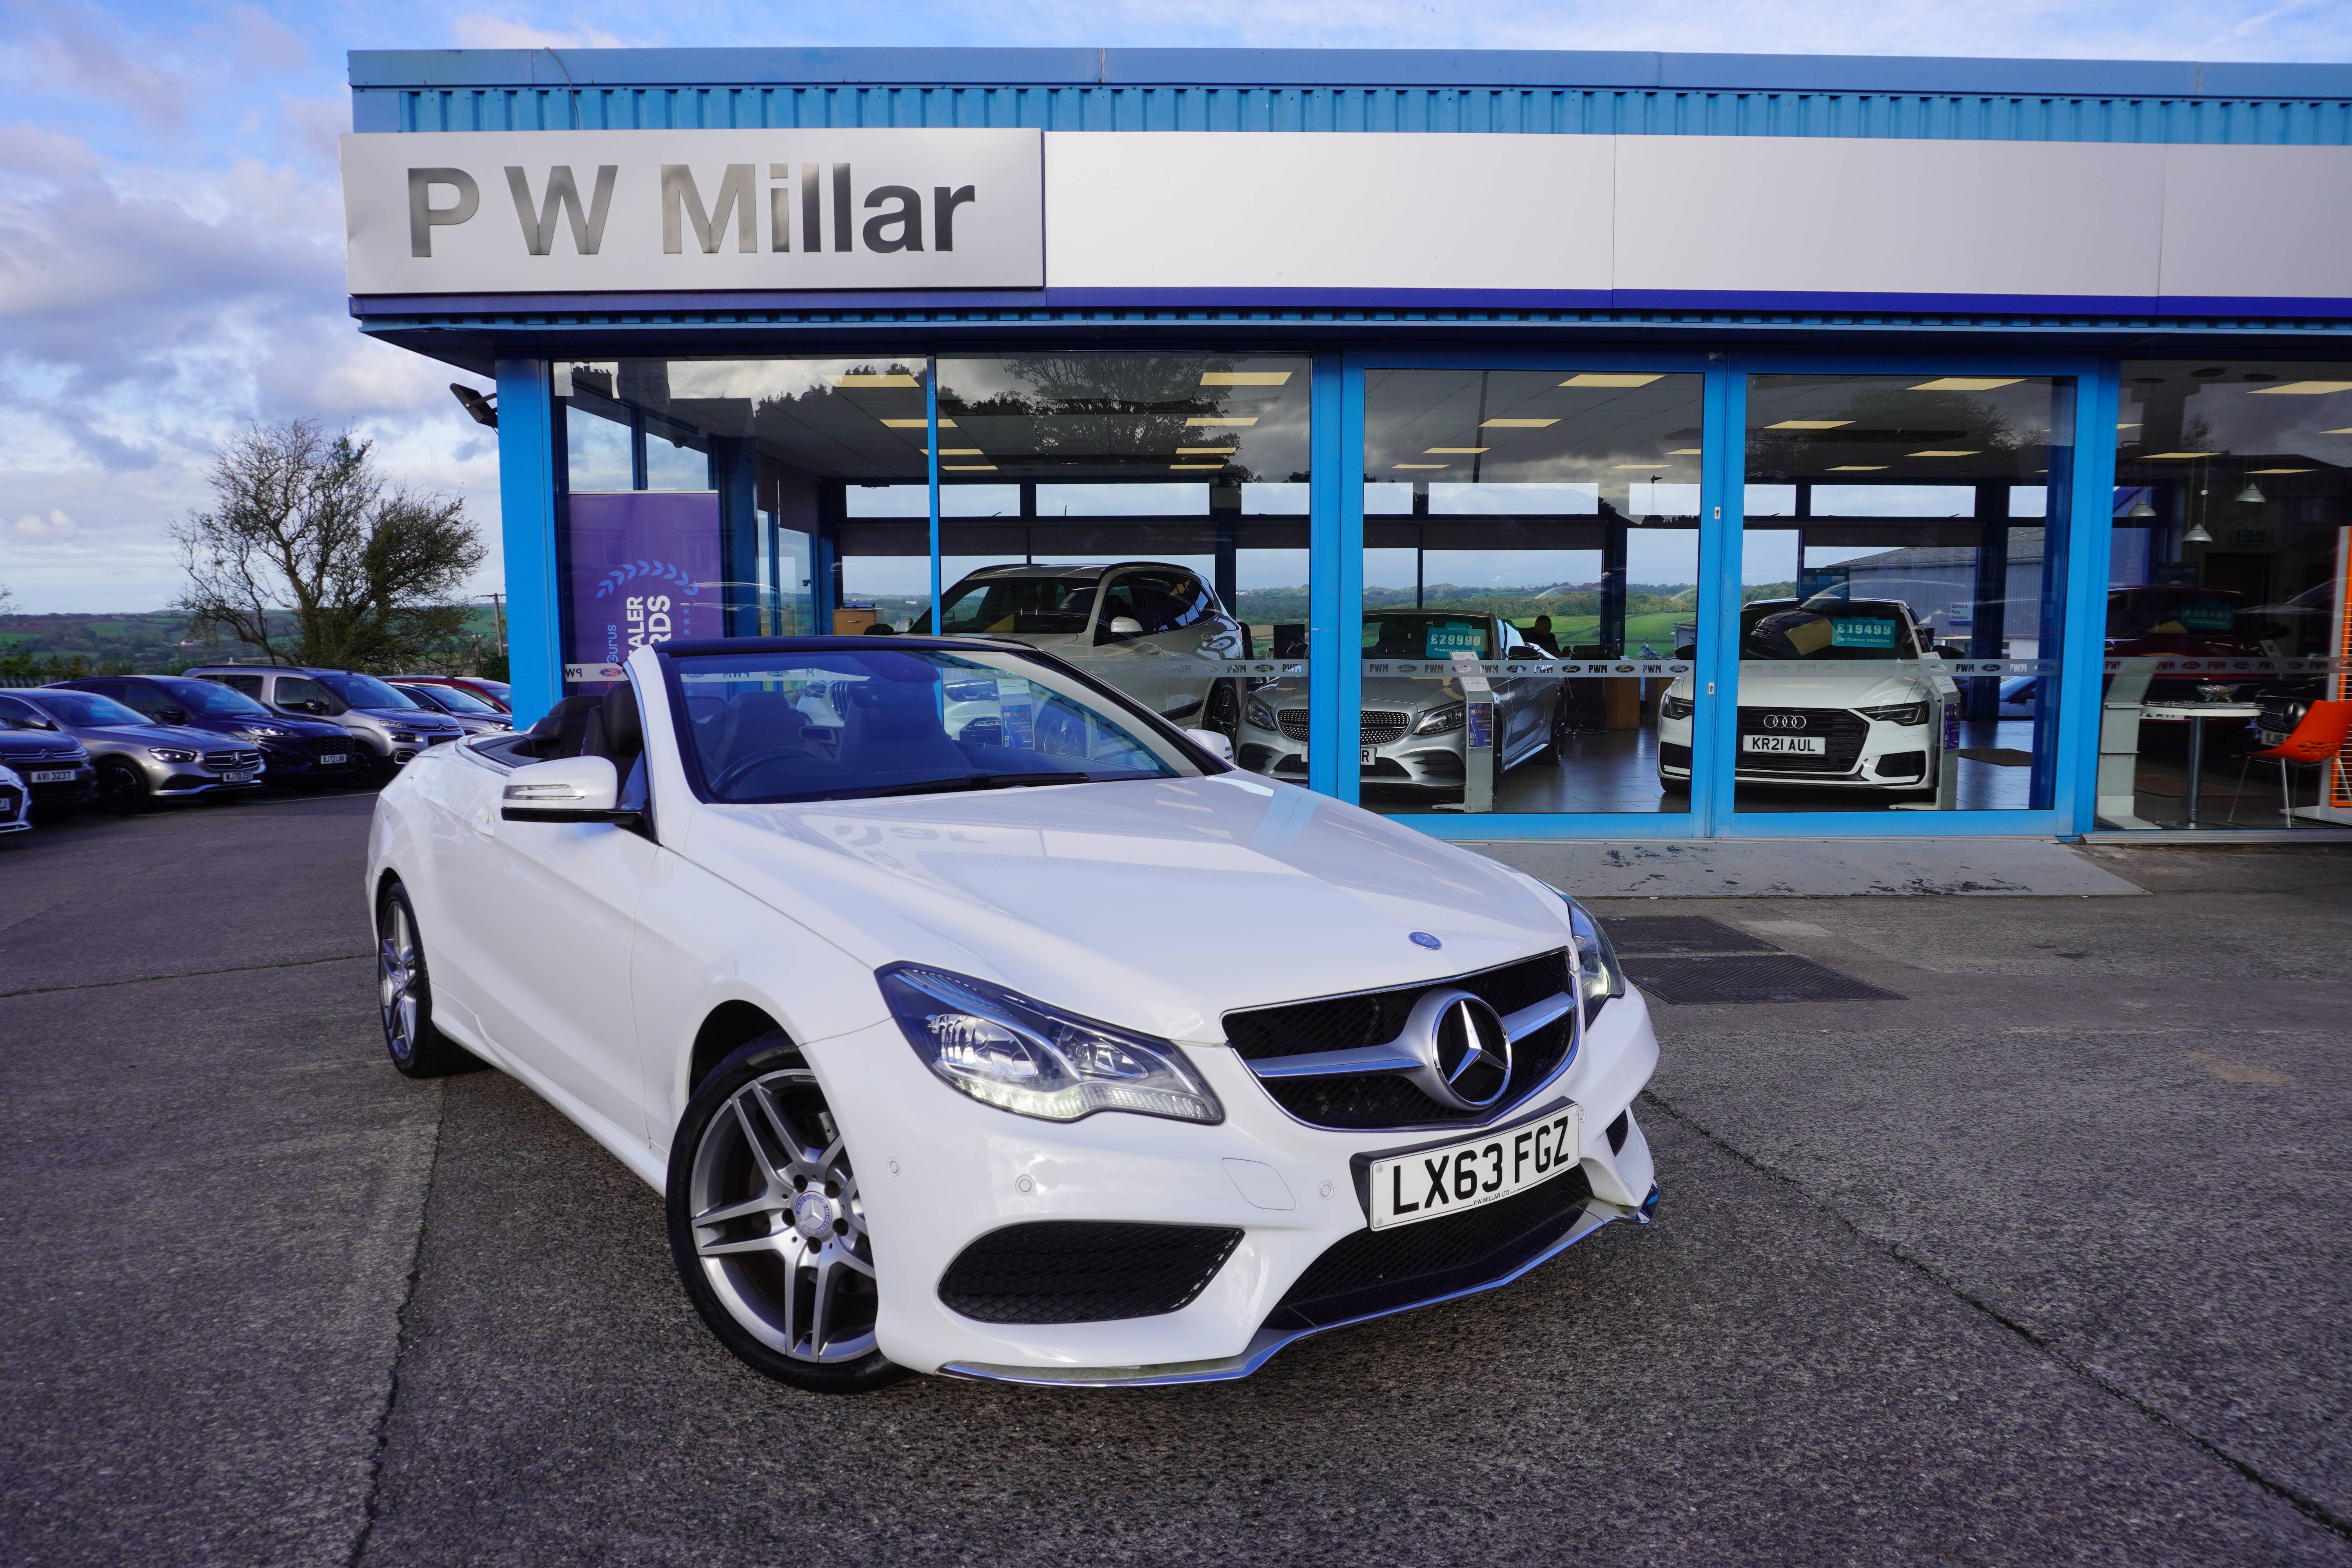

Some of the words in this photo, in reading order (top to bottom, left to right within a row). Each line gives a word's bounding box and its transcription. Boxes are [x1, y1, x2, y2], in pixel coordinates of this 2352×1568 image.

[408, 167, 480, 258] P
[503, 164, 618, 256] W
[660, 162, 976, 254] Millar
[626, 595, 645, 655] ALER
[647, 595, 671, 644] RDS
[1836, 624, 1891, 635] £19499
[1430, 634, 1481, 646] £29990
[1227, 664, 1247, 673] PWM
[1282, 664, 1301, 673] PWM
[1369, 664, 1389, 673] PWM
[1424, 664, 1444, 673] PWM
[1479, 664, 1499, 673] PWM
[1534, 664, 1553, 673] PWM
[1588, 664, 1608, 673] PWM
[1642, 664, 1662, 673] PWM
[1956, 664, 1975, 672] PWM
[2009, 663, 2027, 672] PWM
[1752, 737, 1784, 750] KR21
[1788, 739, 1816, 752] AUL
[51, 771, 71, 780] 3237
[1393, 1142, 1503, 1216] LX63
[1515, 1116, 1569, 1184] FGZ
